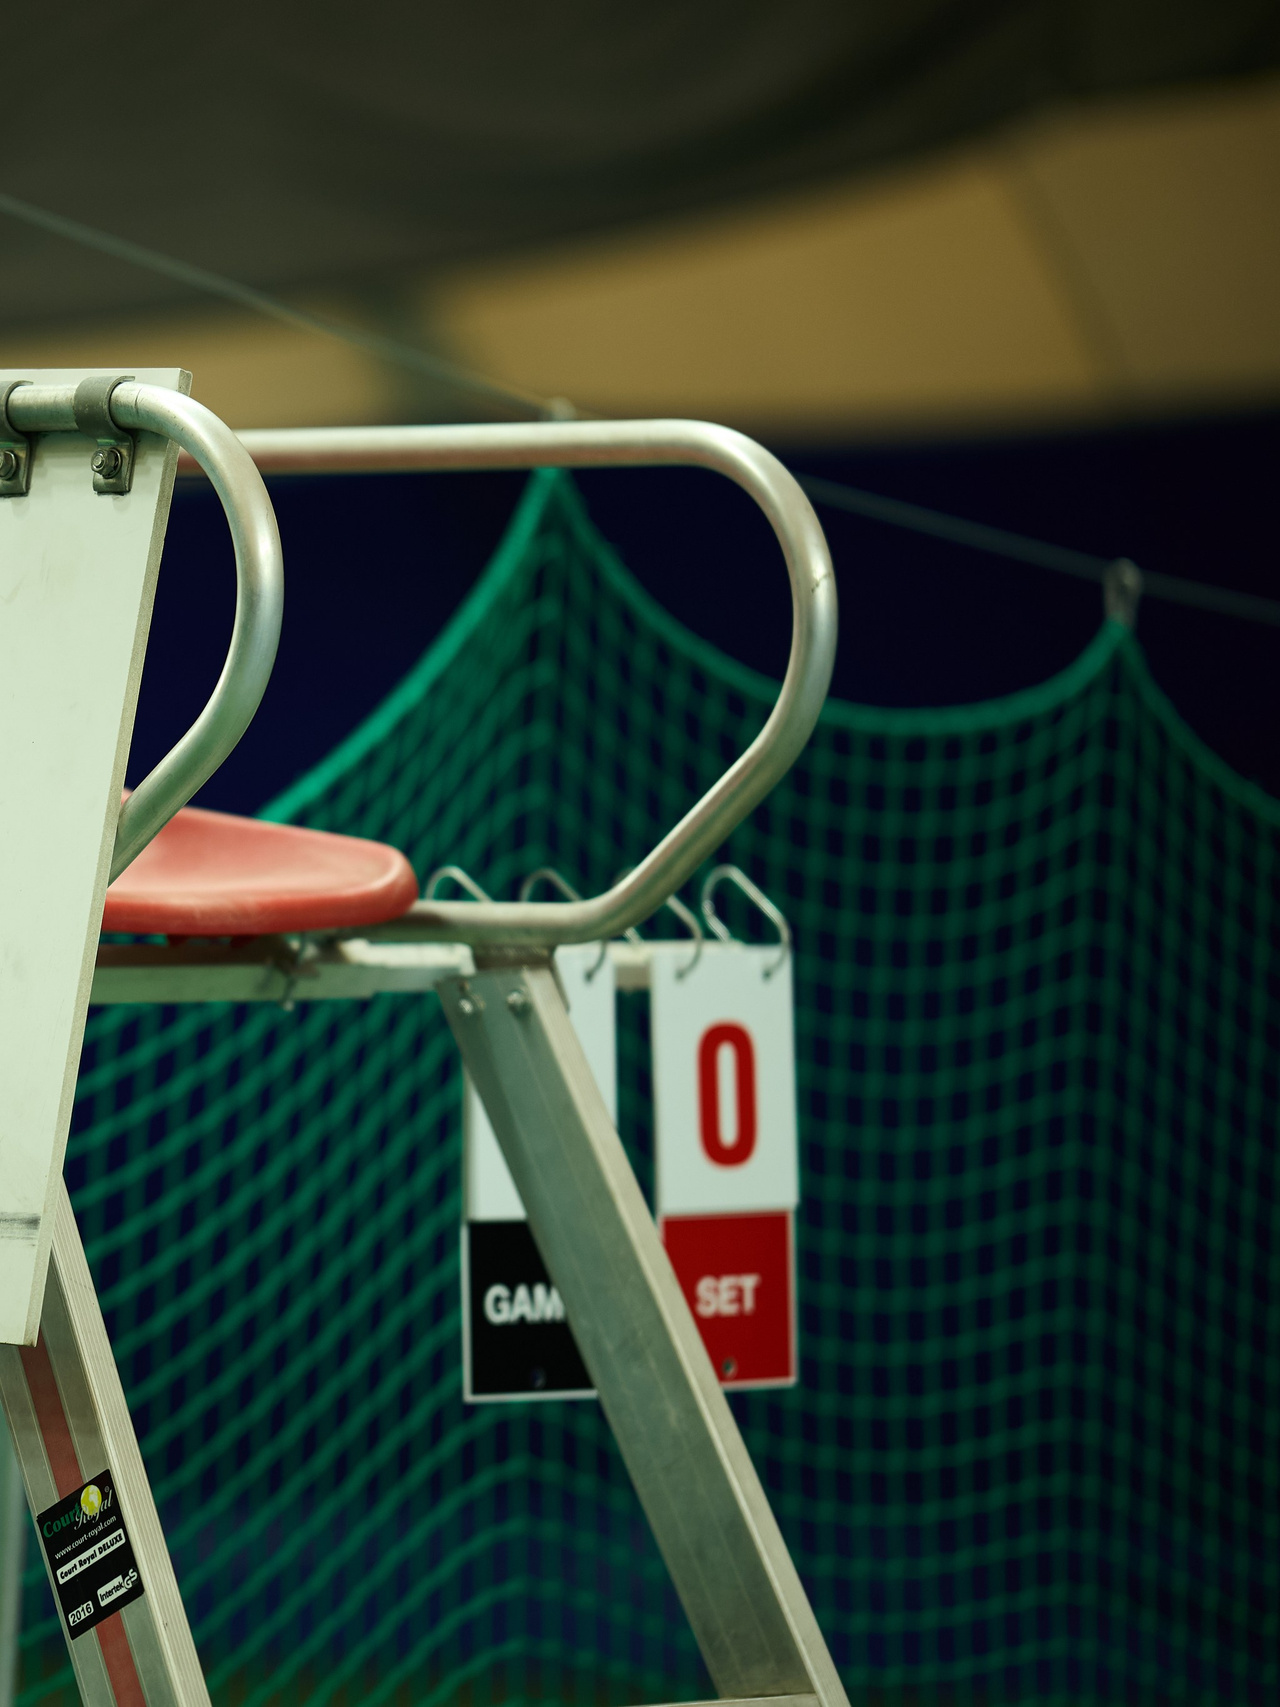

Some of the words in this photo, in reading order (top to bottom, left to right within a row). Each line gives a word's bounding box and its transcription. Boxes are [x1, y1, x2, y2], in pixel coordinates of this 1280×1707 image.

[697, 1020, 758, 1168] 0
[484, 1283, 567, 1325] GAM
[695, 1273, 761, 1318] SET
[42, 1502, 82, 1538] Court
[54, 1515, 117, 1560] www.court-royal.com
[60, 1563, 78, 1580] Court
[78, 1551, 98, 1570] Royal
[98, 1533, 124, 1556] DELUXE
[70, 1603, 93, 1624] 2016
[99, 1582, 125, 1602] Intertek
